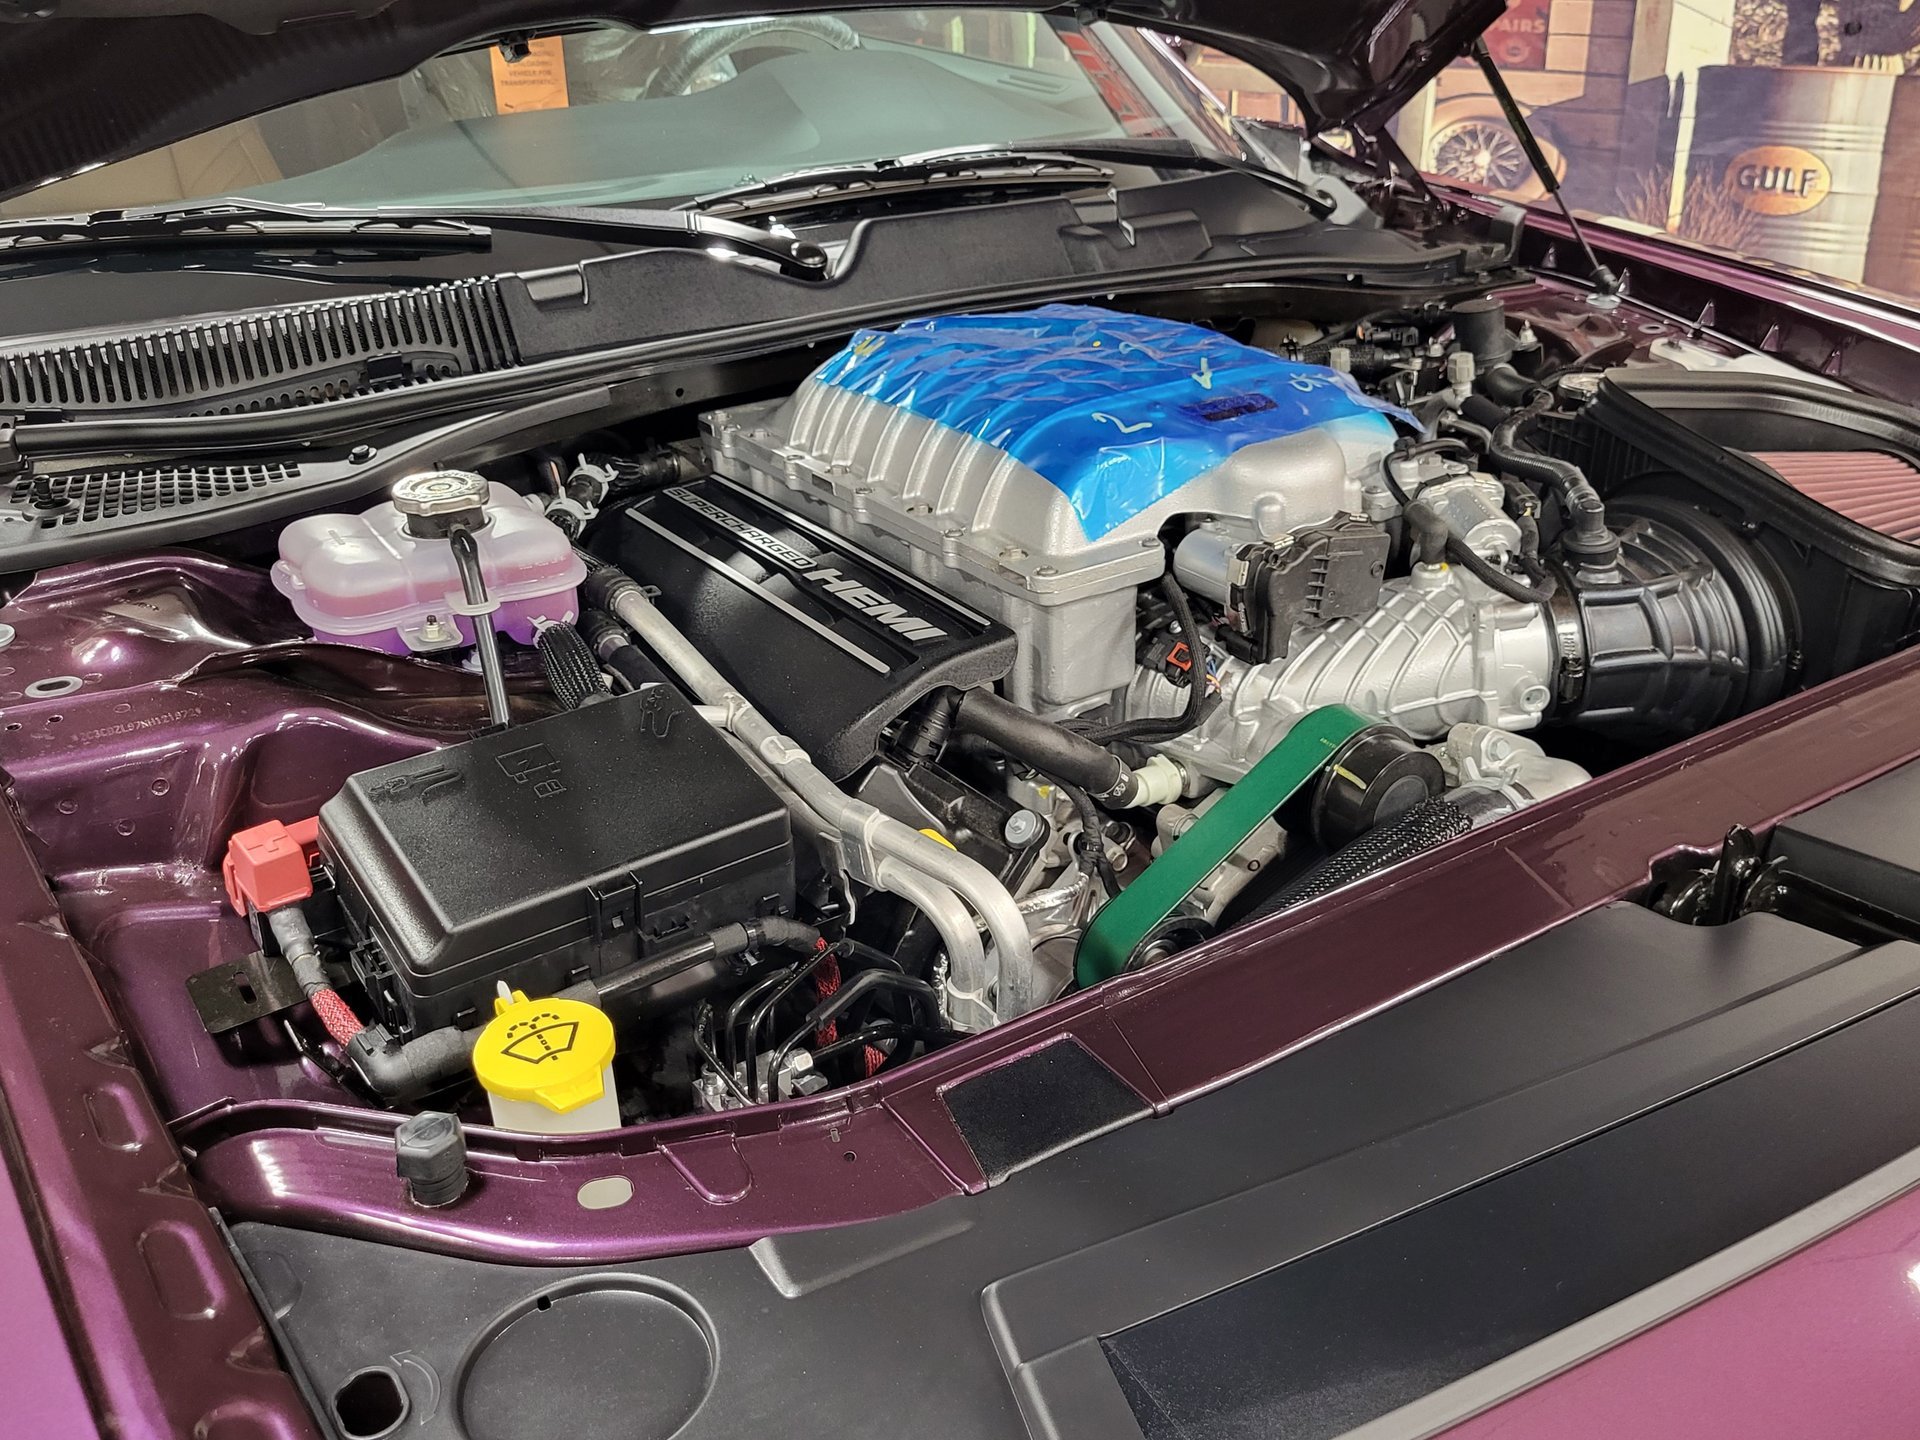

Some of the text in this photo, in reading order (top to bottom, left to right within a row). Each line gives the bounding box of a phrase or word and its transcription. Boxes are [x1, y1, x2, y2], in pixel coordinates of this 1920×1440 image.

[1737, 164, 1819, 199] GULF
[665, 486, 949, 642] SUPERCHARGED HEMI
